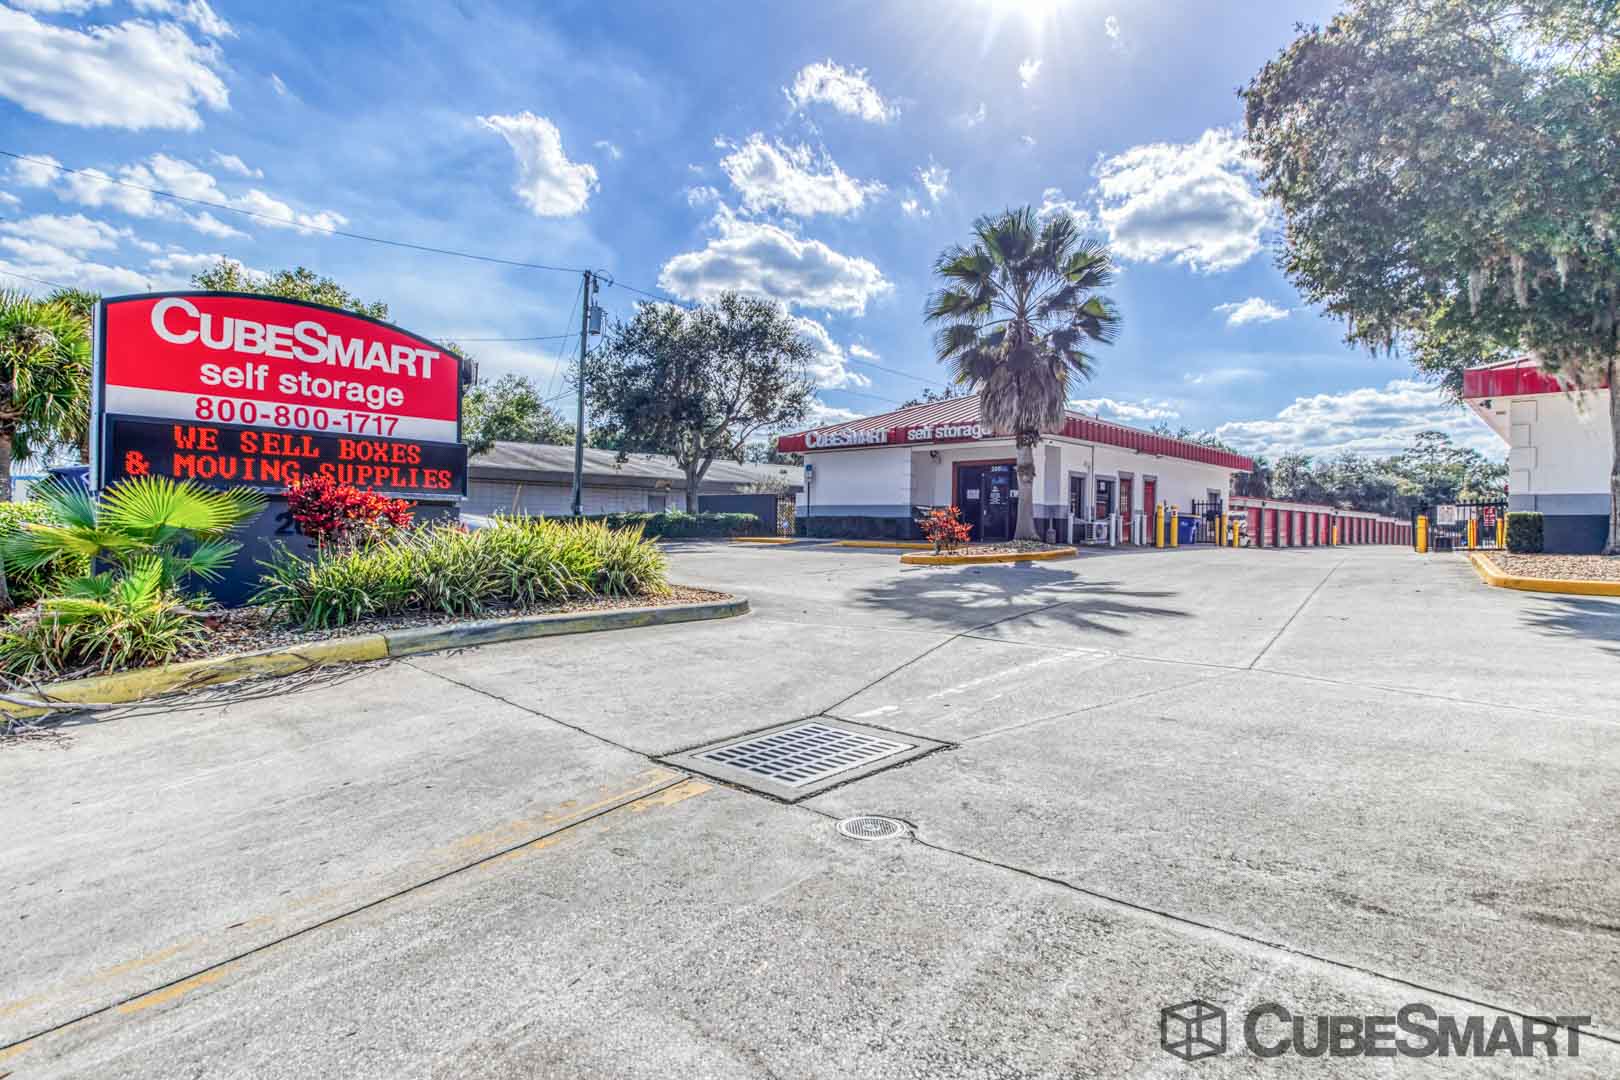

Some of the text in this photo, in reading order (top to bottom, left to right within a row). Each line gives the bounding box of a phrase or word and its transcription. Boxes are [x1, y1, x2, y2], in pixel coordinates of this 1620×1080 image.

[200, 361, 405, 409] self storage
[195, 397, 400, 437] 800-800-1717
[907, 426, 932, 441] self
[174, 425, 422, 464] WE SELL BOXES
[125, 450, 150, 476] &
[319, 462, 452, 489] SUPPLIES
